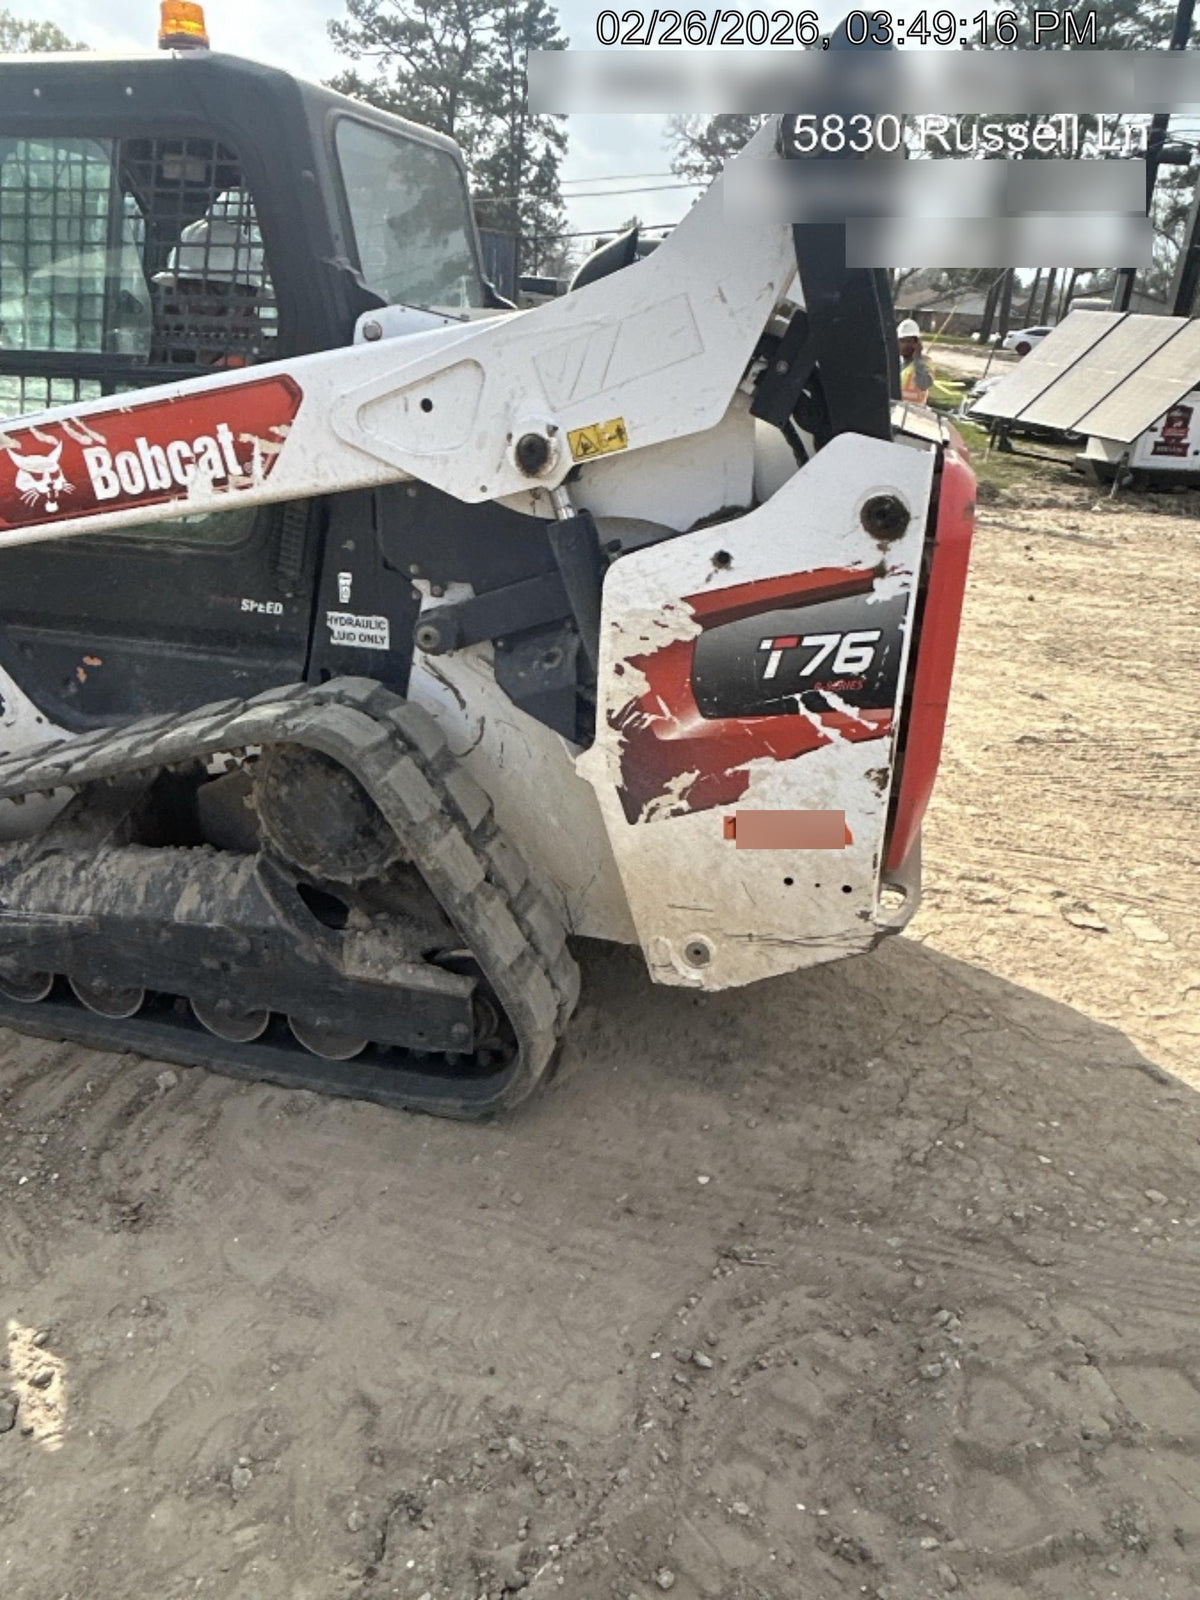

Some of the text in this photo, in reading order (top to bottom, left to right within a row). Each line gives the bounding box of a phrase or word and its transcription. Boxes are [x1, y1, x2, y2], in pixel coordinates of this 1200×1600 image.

[82, 422, 243, 501] Bobcat
[241, 598, 284, 615] SPEED
[358, 632, 387, 645] ONLY
[759, 630, 882, 679] T76
